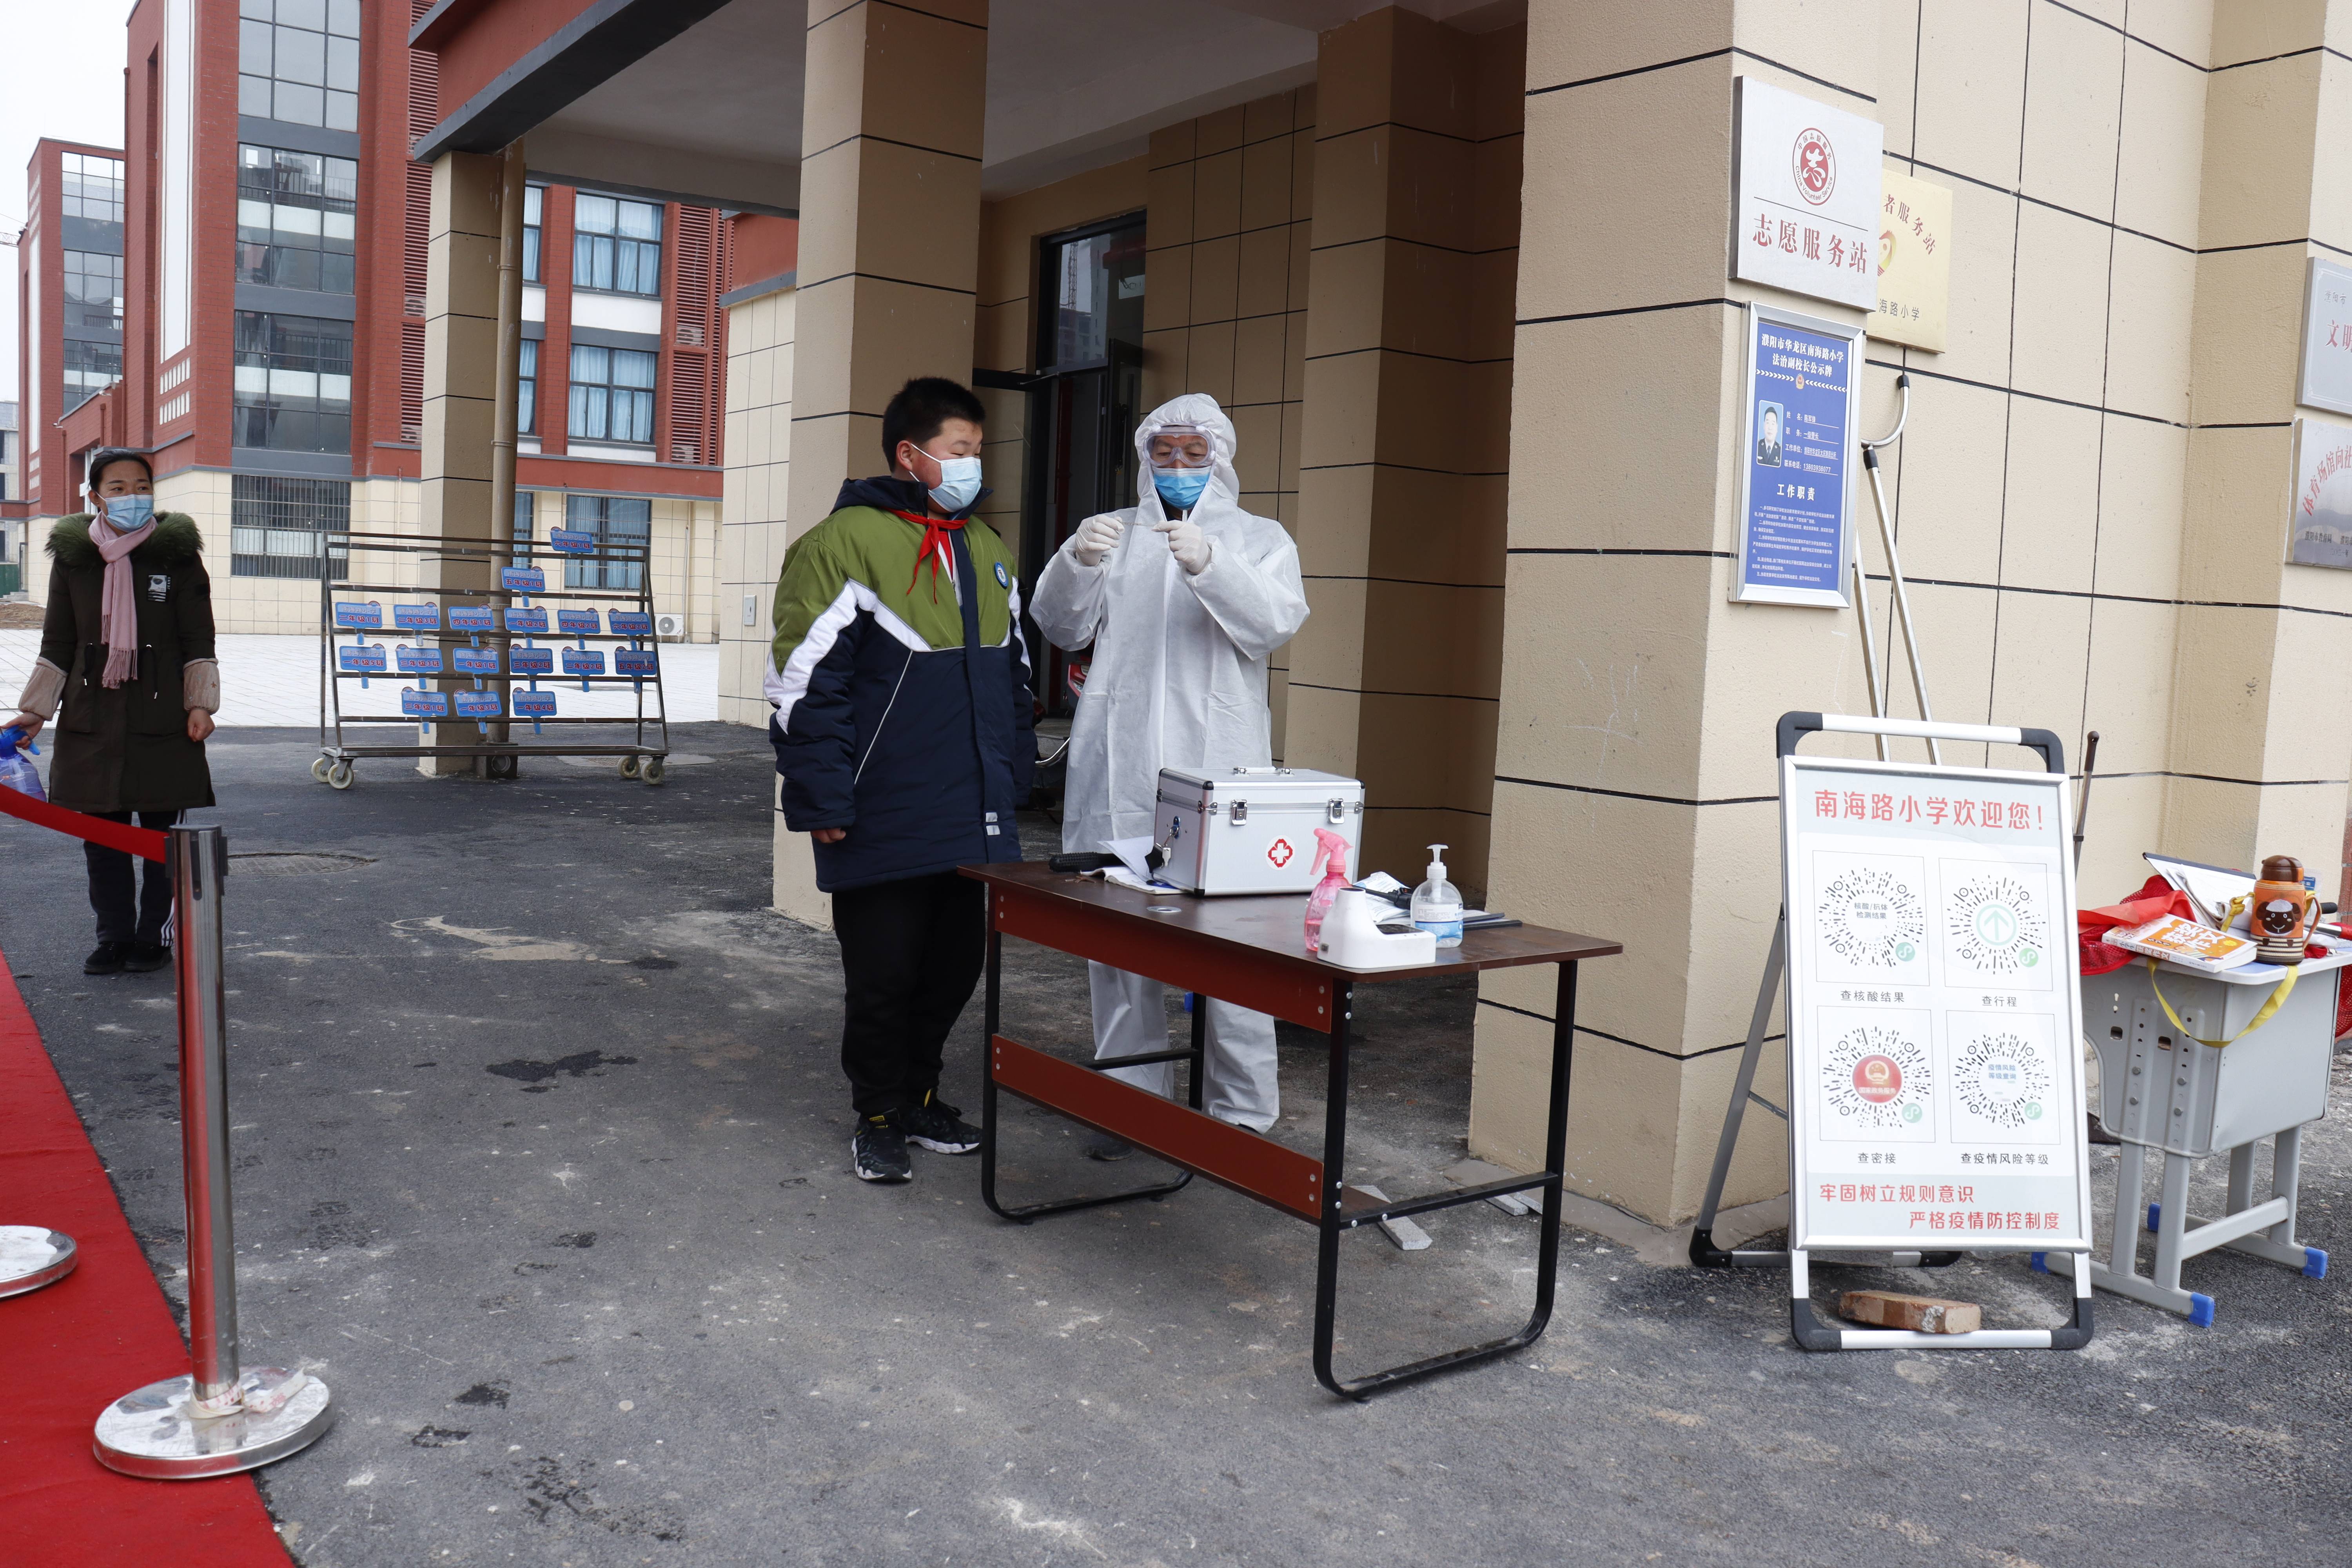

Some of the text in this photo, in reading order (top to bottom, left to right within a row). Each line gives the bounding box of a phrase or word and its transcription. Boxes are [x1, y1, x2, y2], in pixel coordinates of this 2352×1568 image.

[1798, 132, 1832, 160] 中国志愿服务
[1802, 185, 1822, 201] Volunteer
[1822, 176, 1833, 198] Service
[1884, 194, 1936, 255] 者服务站
[1753, 213, 1867, 274] 志愿服务站
[1879, 299, 1920, 321] 海路小学
[1762, 333, 1844, 363] 濮阳市华龙区南海路小学
[1772, 353, 1833, 377] 法治副校长公示牌
[1777, 483, 1815, 501] 工作职责
[555, 541, 590, 549] 六年级1班
[506, 579, 543, 587] 五年级1班
[339, 615, 380, 623] 二年级1班
[405, 703, 445, 711] 三年级1班
[460, 703, 498, 711] 一年级3班
[516, 703, 554, 711] 一年级4班
[1815, 789, 2043, 830] 南海路小学欢迎您！
[1840, 990, 1905, 1003] 查核酸结果
[1982, 995, 2017, 1007] 查行程
[1858, 1152, 1896, 1164] 查密接
[1961, 1152, 2049, 1165] 查疫情风险等级
[1820, 1183, 1975, 1203] 牢固树立规则意识
[1909, 1210, 2060, 1230] 严格疫情防控制度
